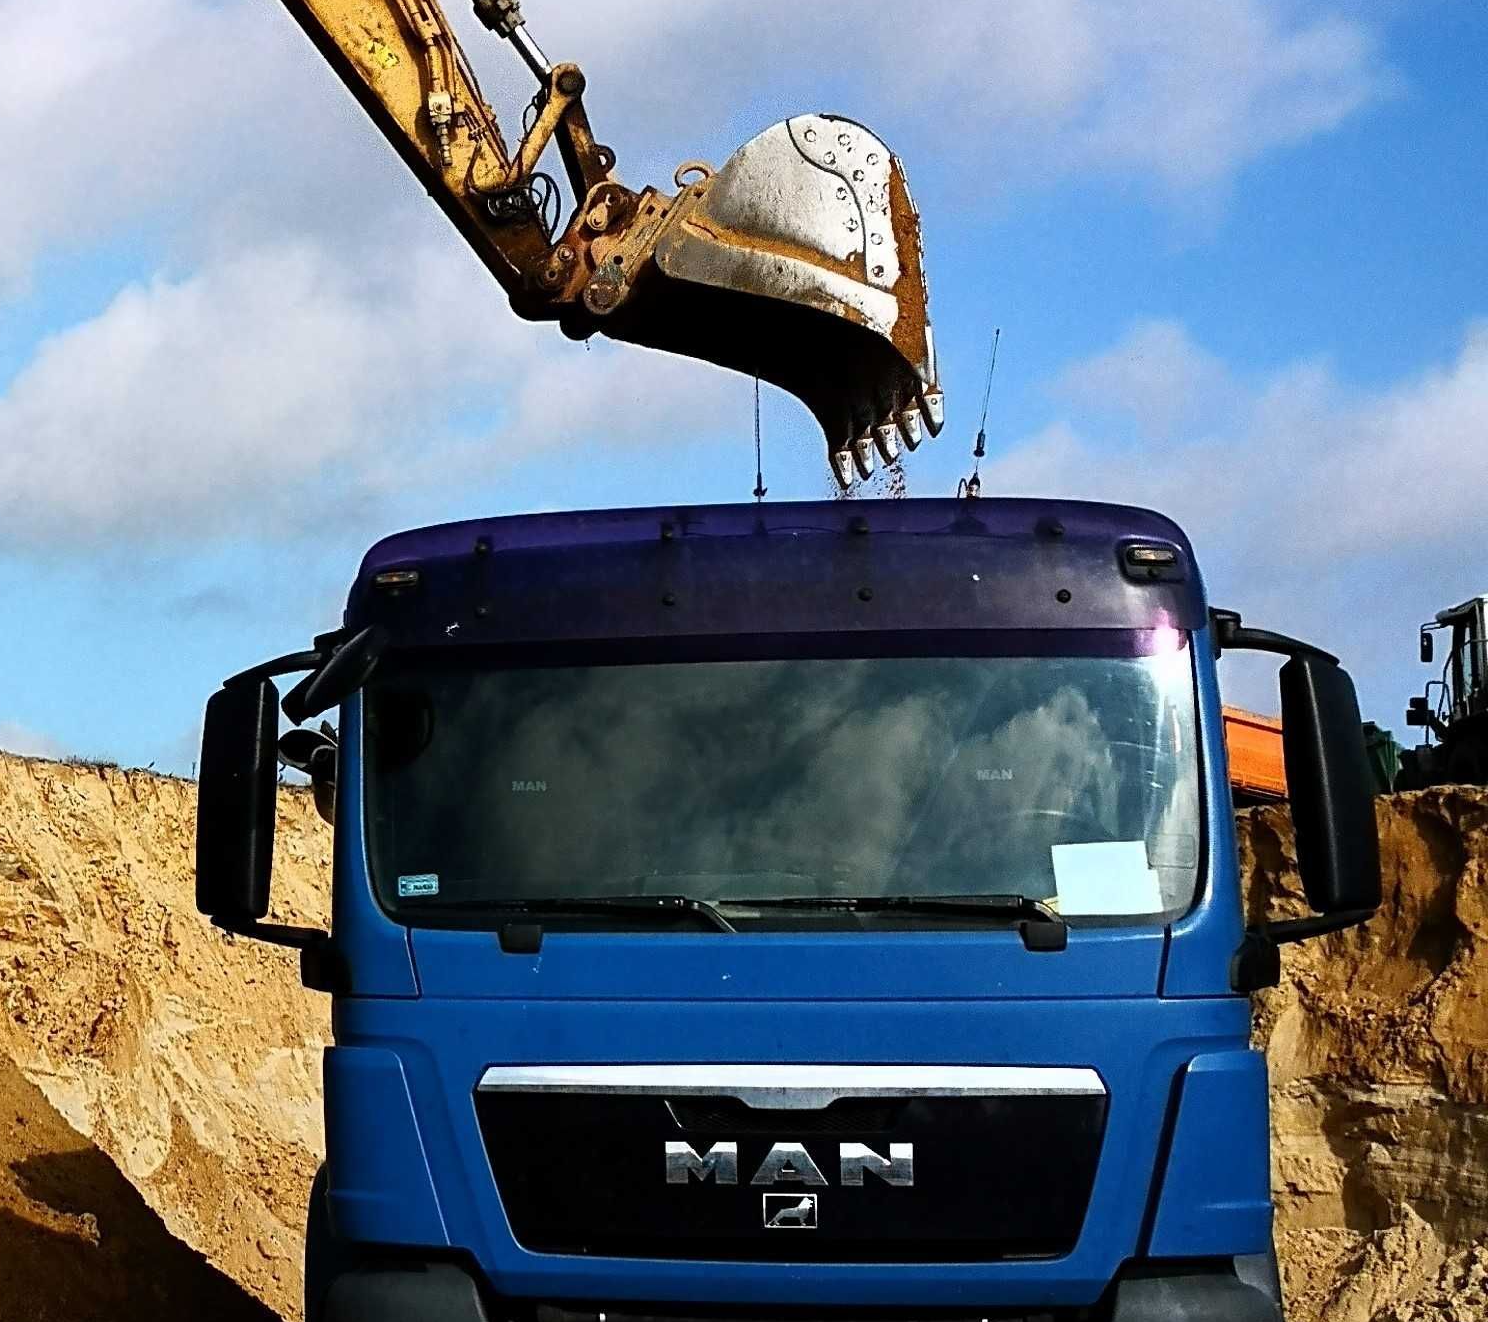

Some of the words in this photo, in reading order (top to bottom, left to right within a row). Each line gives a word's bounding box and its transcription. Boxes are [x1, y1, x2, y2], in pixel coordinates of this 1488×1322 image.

[976, 768, 1012, 781] MAN
[512, 780, 546, 792] MAN
[665, 1141, 914, 1186] MAN
